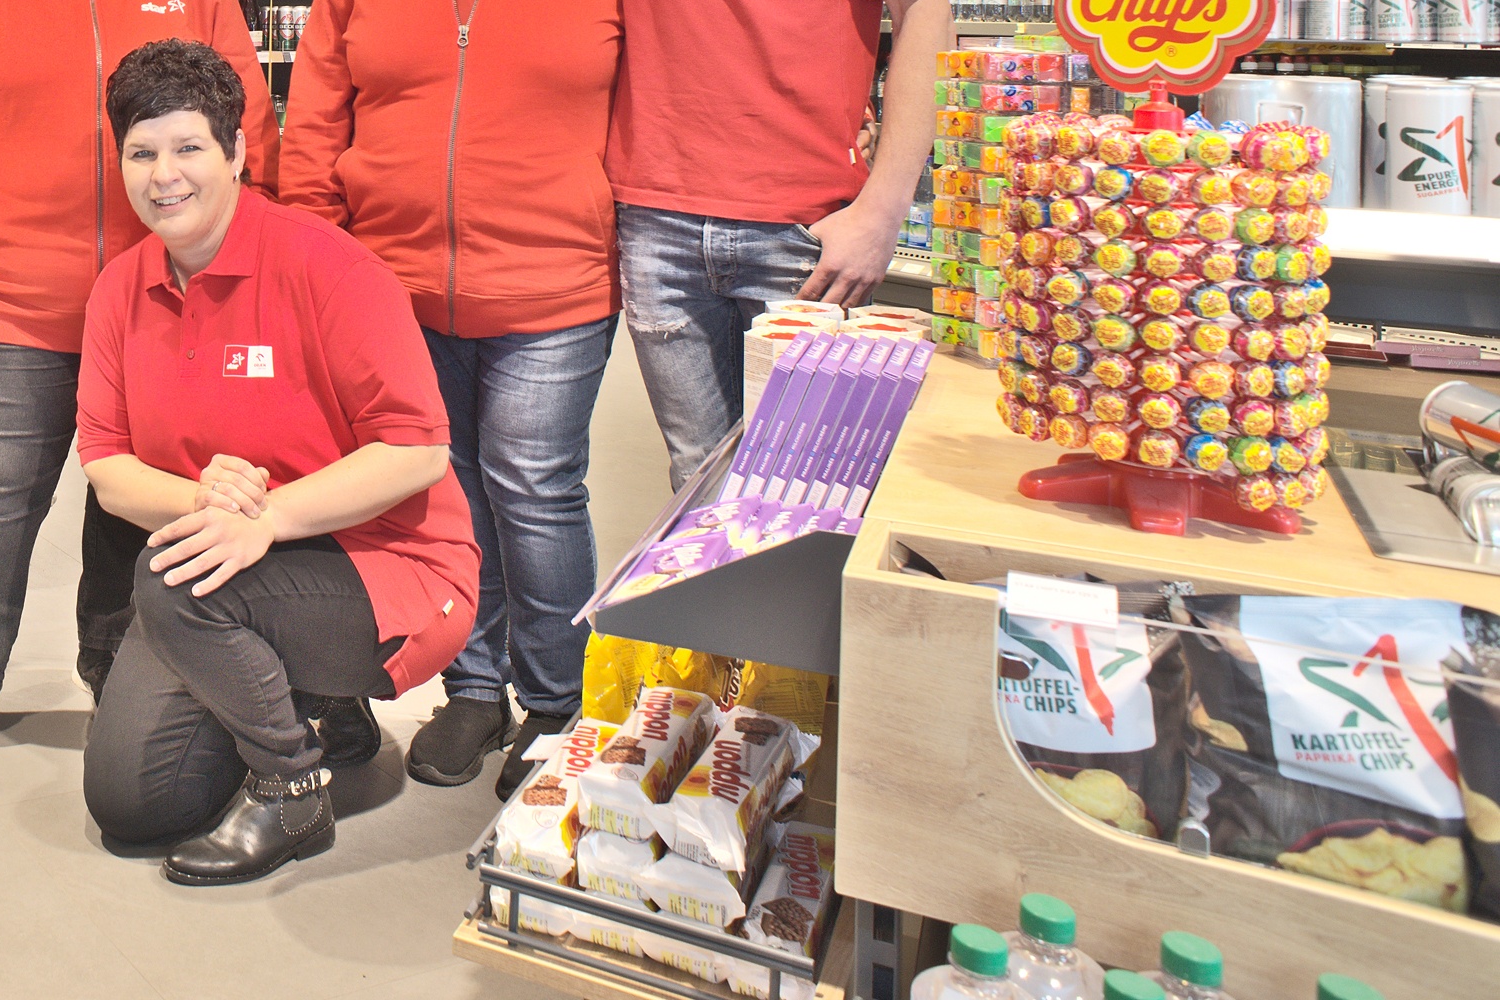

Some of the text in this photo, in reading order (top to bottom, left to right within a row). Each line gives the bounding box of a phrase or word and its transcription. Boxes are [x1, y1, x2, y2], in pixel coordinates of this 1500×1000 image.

[141, 2, 167, 14] star
[1427, 169, 1457, 181] PURE
[1414, 178, 1460, 192] ENERGY
[1416, 188, 1461, 198] SUGARFREE
[1024, 695, 1077, 714] CHIPS
[642, 690, 674, 741] nippon
[1291, 732, 1411, 751] KARTOFFEL-
[563, 726, 599, 778] nippon
[1295, 752, 1415, 771] PAPRIKA CHIPS
[708, 739, 750, 804] nippon
[779, 833, 822, 901] nippon
